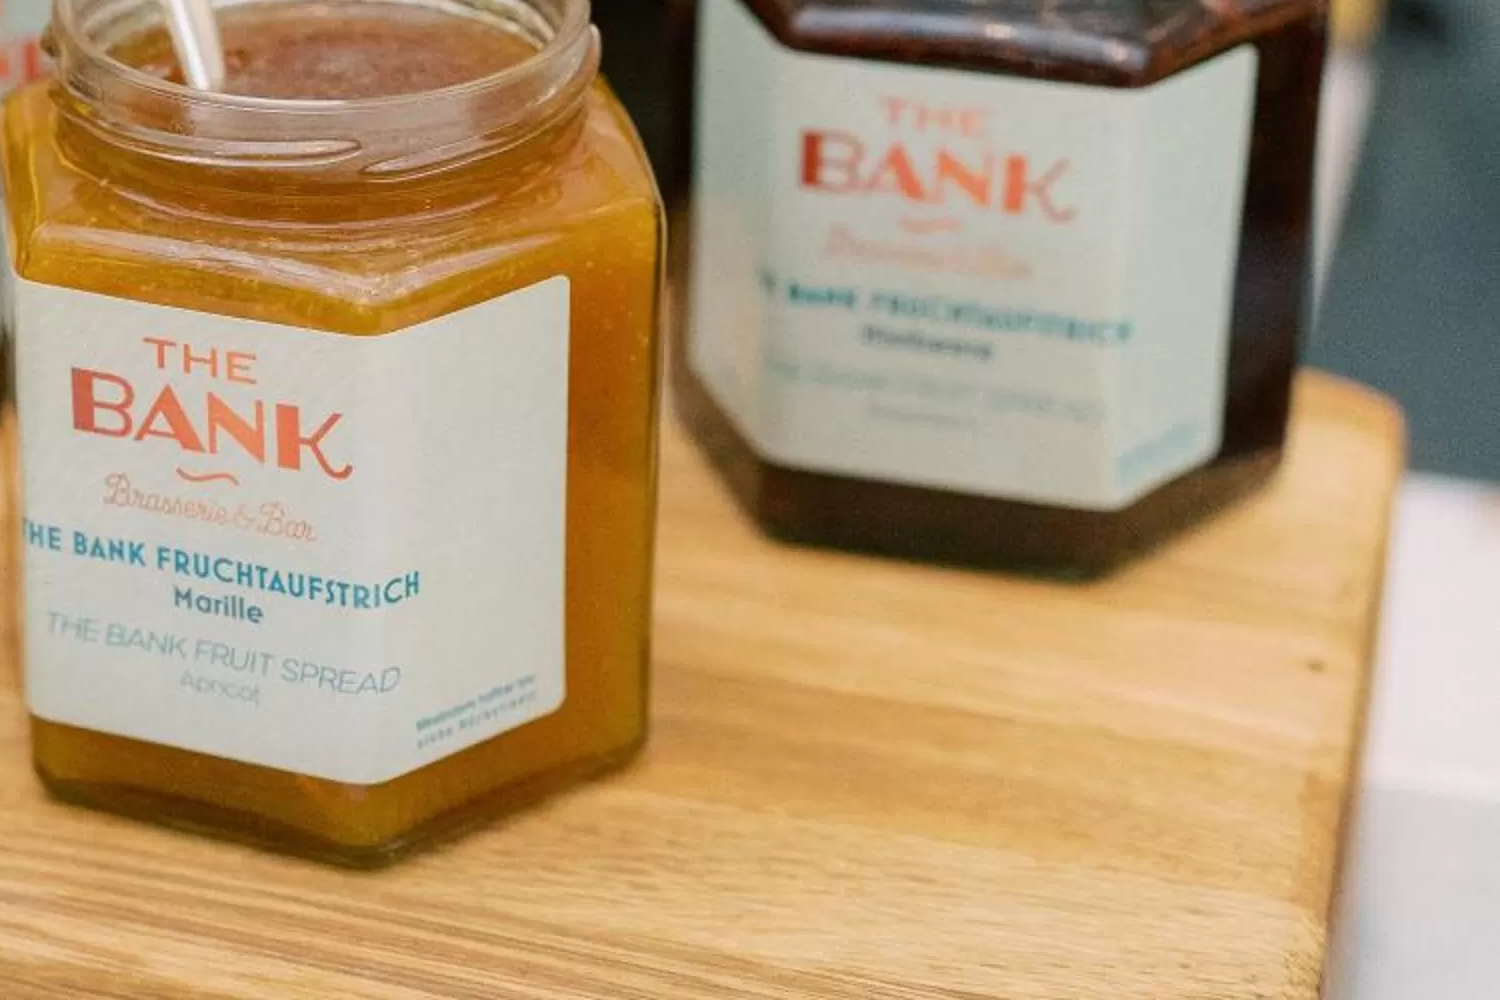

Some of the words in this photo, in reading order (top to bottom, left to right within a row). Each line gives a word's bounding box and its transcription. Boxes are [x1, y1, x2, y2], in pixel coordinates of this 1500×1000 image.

[800, 129, 1078, 224] BANK
[142, 336, 257, 385] THE
[70, 367, 353, 480] BANK
[102, 471, 229, 526] Brasserie
[256, 500, 317, 542] Bar
[23, 518, 62, 551] THE
[73, 531, 146, 567] BANK
[157, 545, 421, 610] FRUCHTAUFSTRICH
[173, 585, 264, 624] Marille
[47, 611, 100, 643] THE
[104, 622, 188, 660] BANK
[194, 638, 275, 677] FRUIT
[280, 657, 401, 698] SPREAD
[179, 669, 261, 706] Apricot
